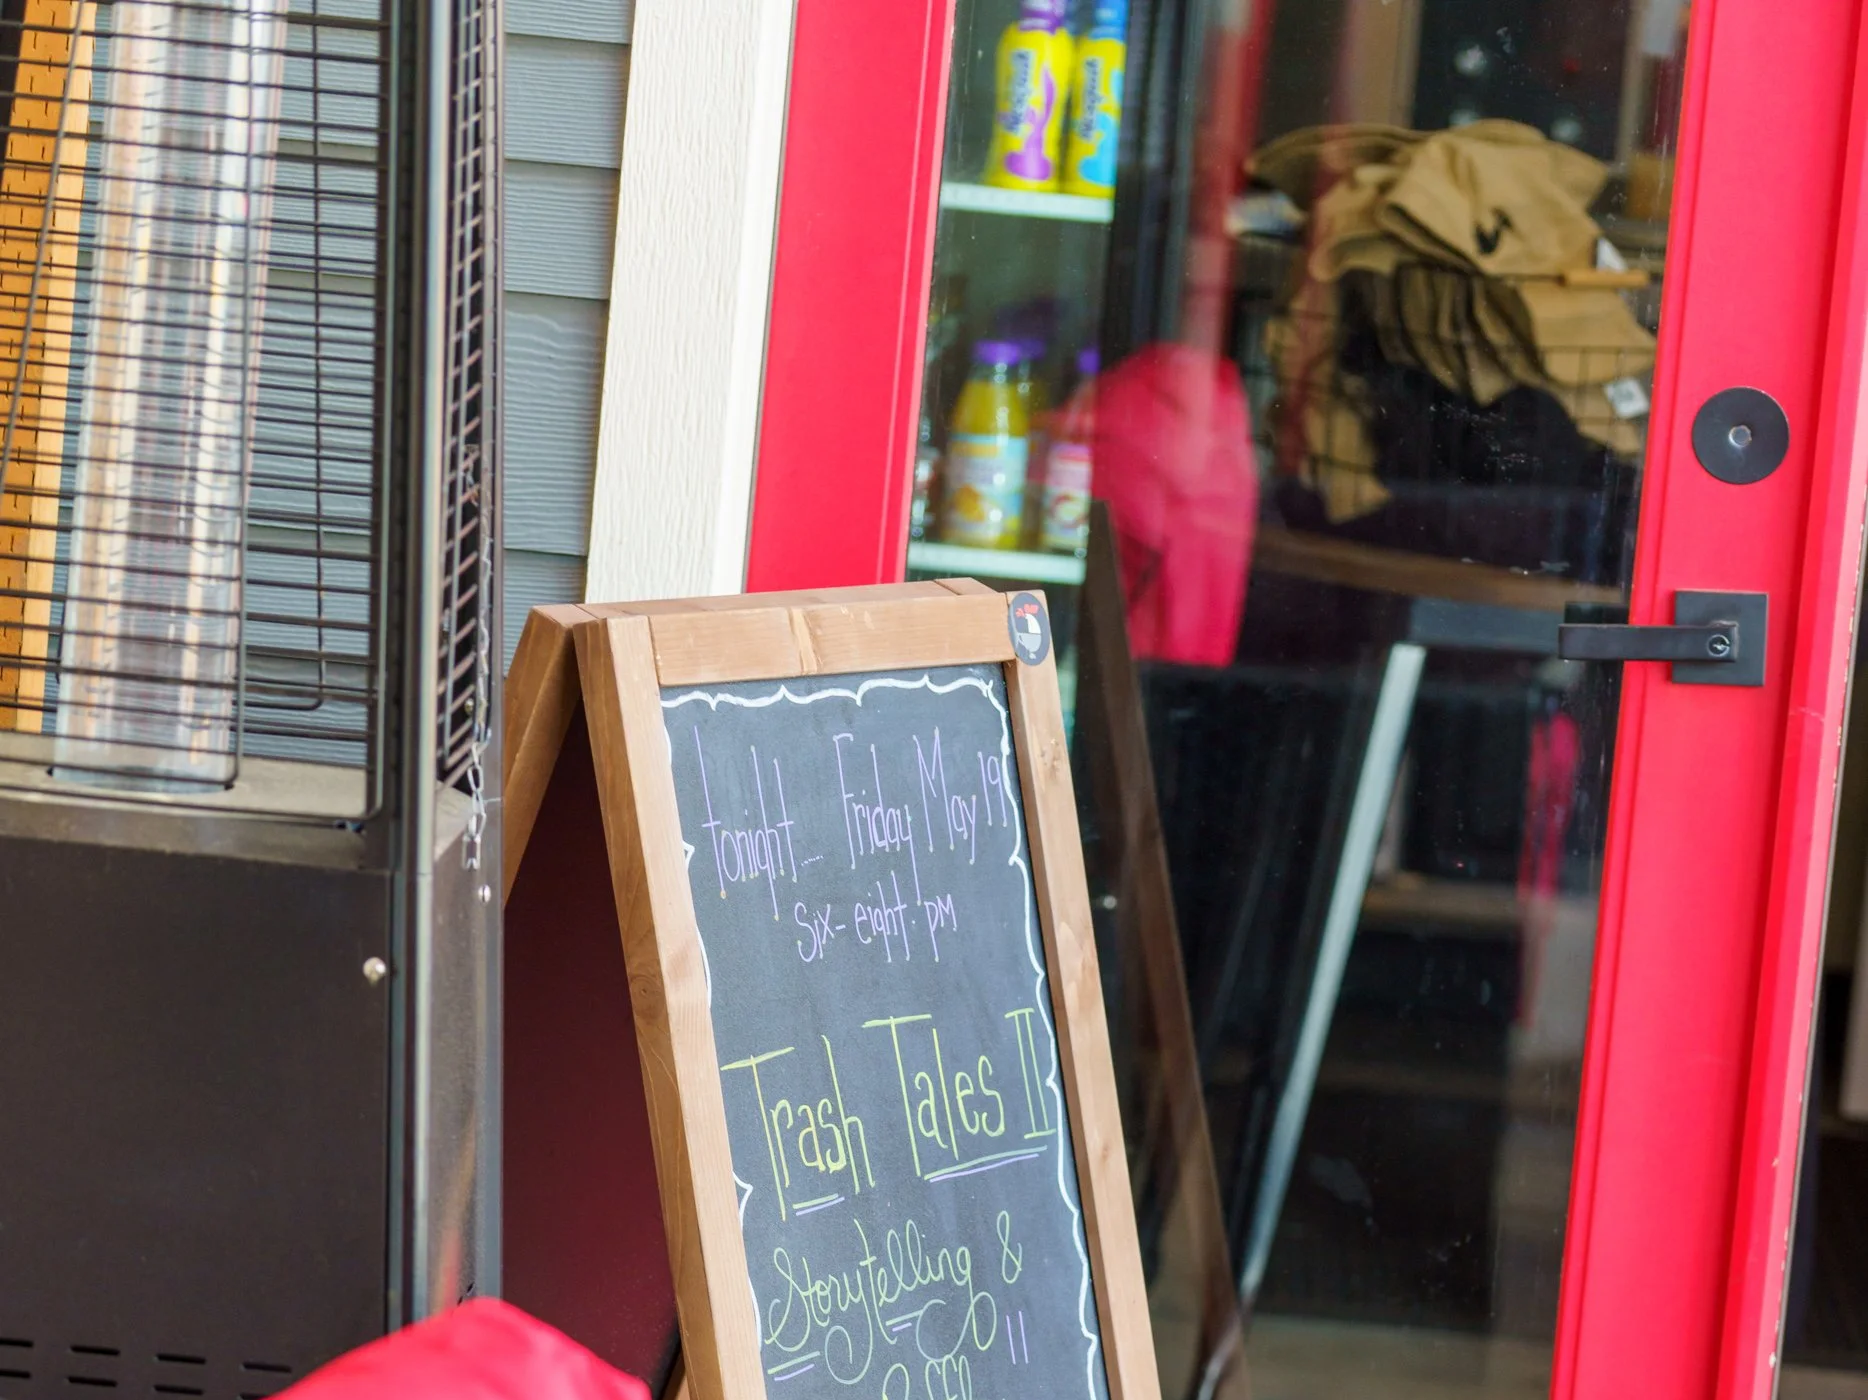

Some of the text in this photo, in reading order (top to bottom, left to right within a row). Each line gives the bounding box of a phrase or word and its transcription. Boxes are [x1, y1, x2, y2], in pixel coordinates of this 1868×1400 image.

[833, 733, 921, 906] Friday
[912, 726, 977, 865] May
[977, 751, 1007, 827] 19
[720, 1034, 876, 1221] Trash
[861, 1013, 1005, 1176] Tales
[765, 1210, 1022, 1384] Storytelling &
